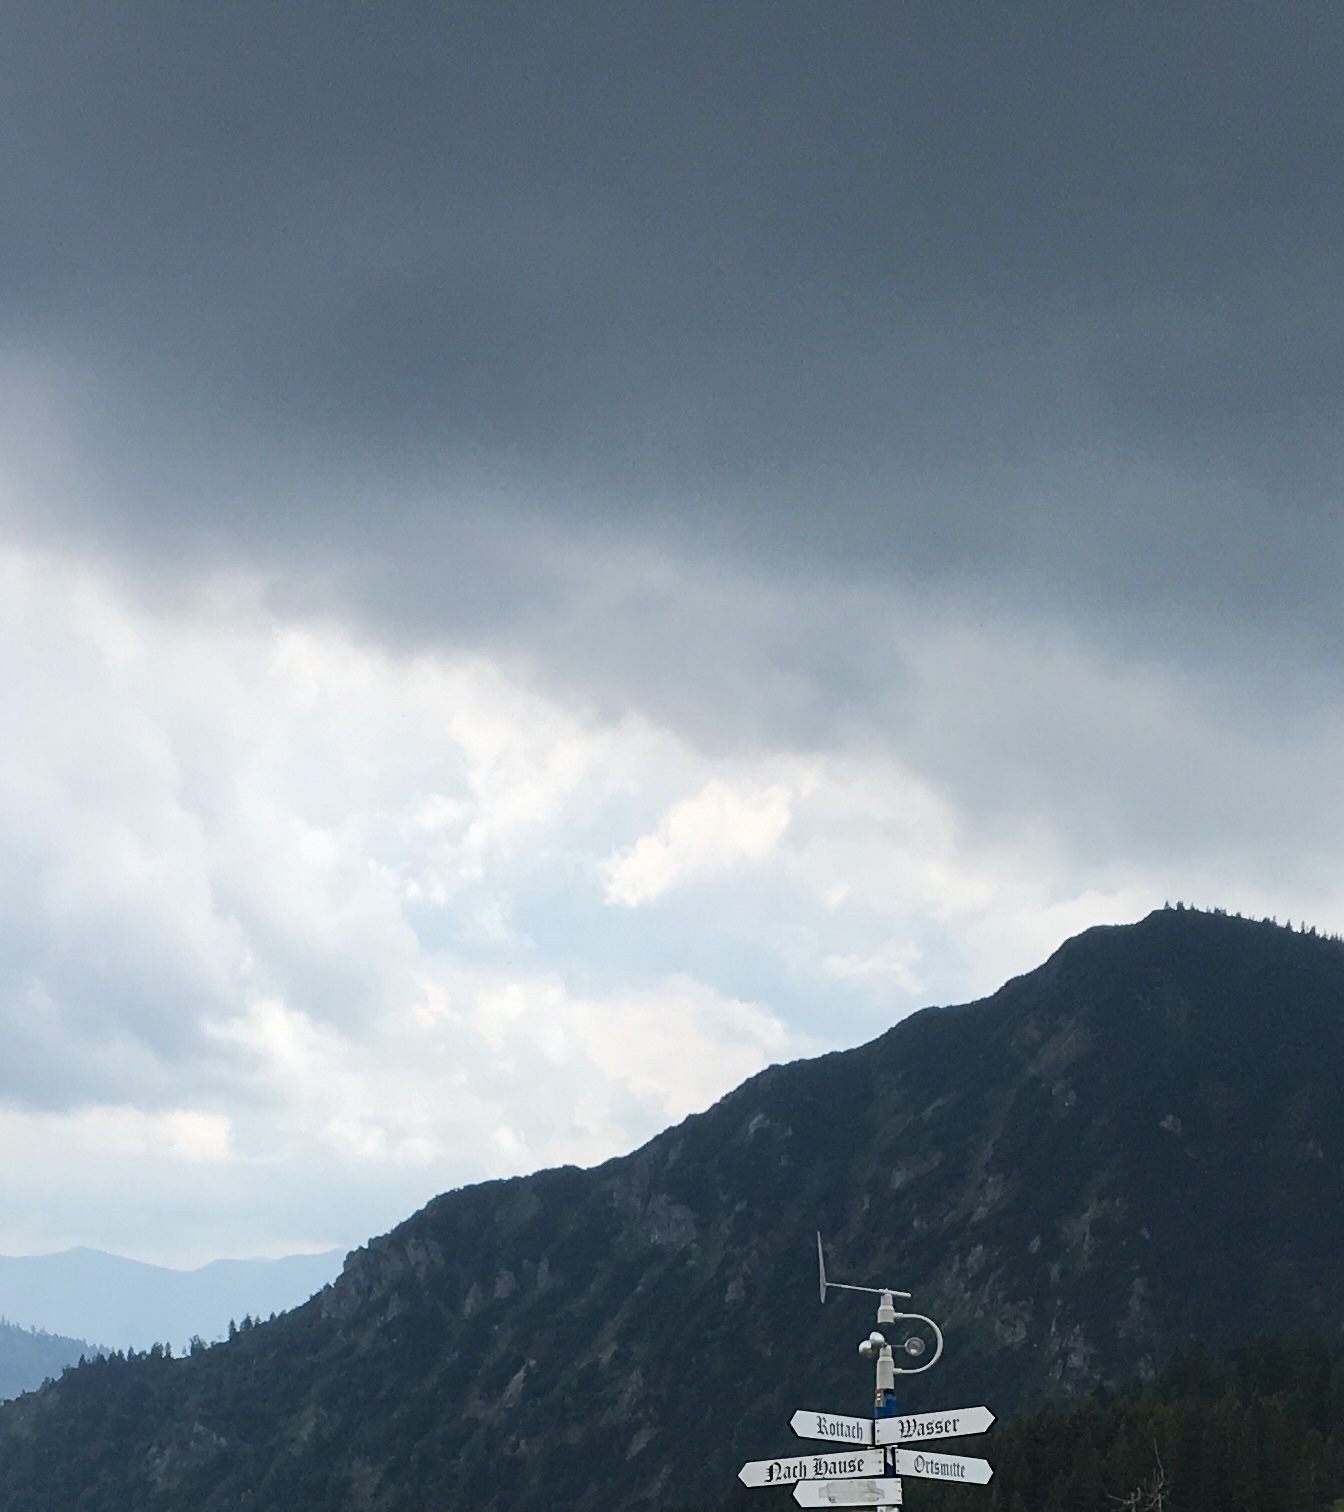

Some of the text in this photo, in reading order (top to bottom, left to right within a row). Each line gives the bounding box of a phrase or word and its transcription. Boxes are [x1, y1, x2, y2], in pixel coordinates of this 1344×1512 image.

[815, 1415, 863, 1441] Rottach
[898, 1417, 960, 1438] Wasser
[763, 1457, 865, 1482] Nach Hause
[913, 1454, 966, 1479] Ortsmitte
